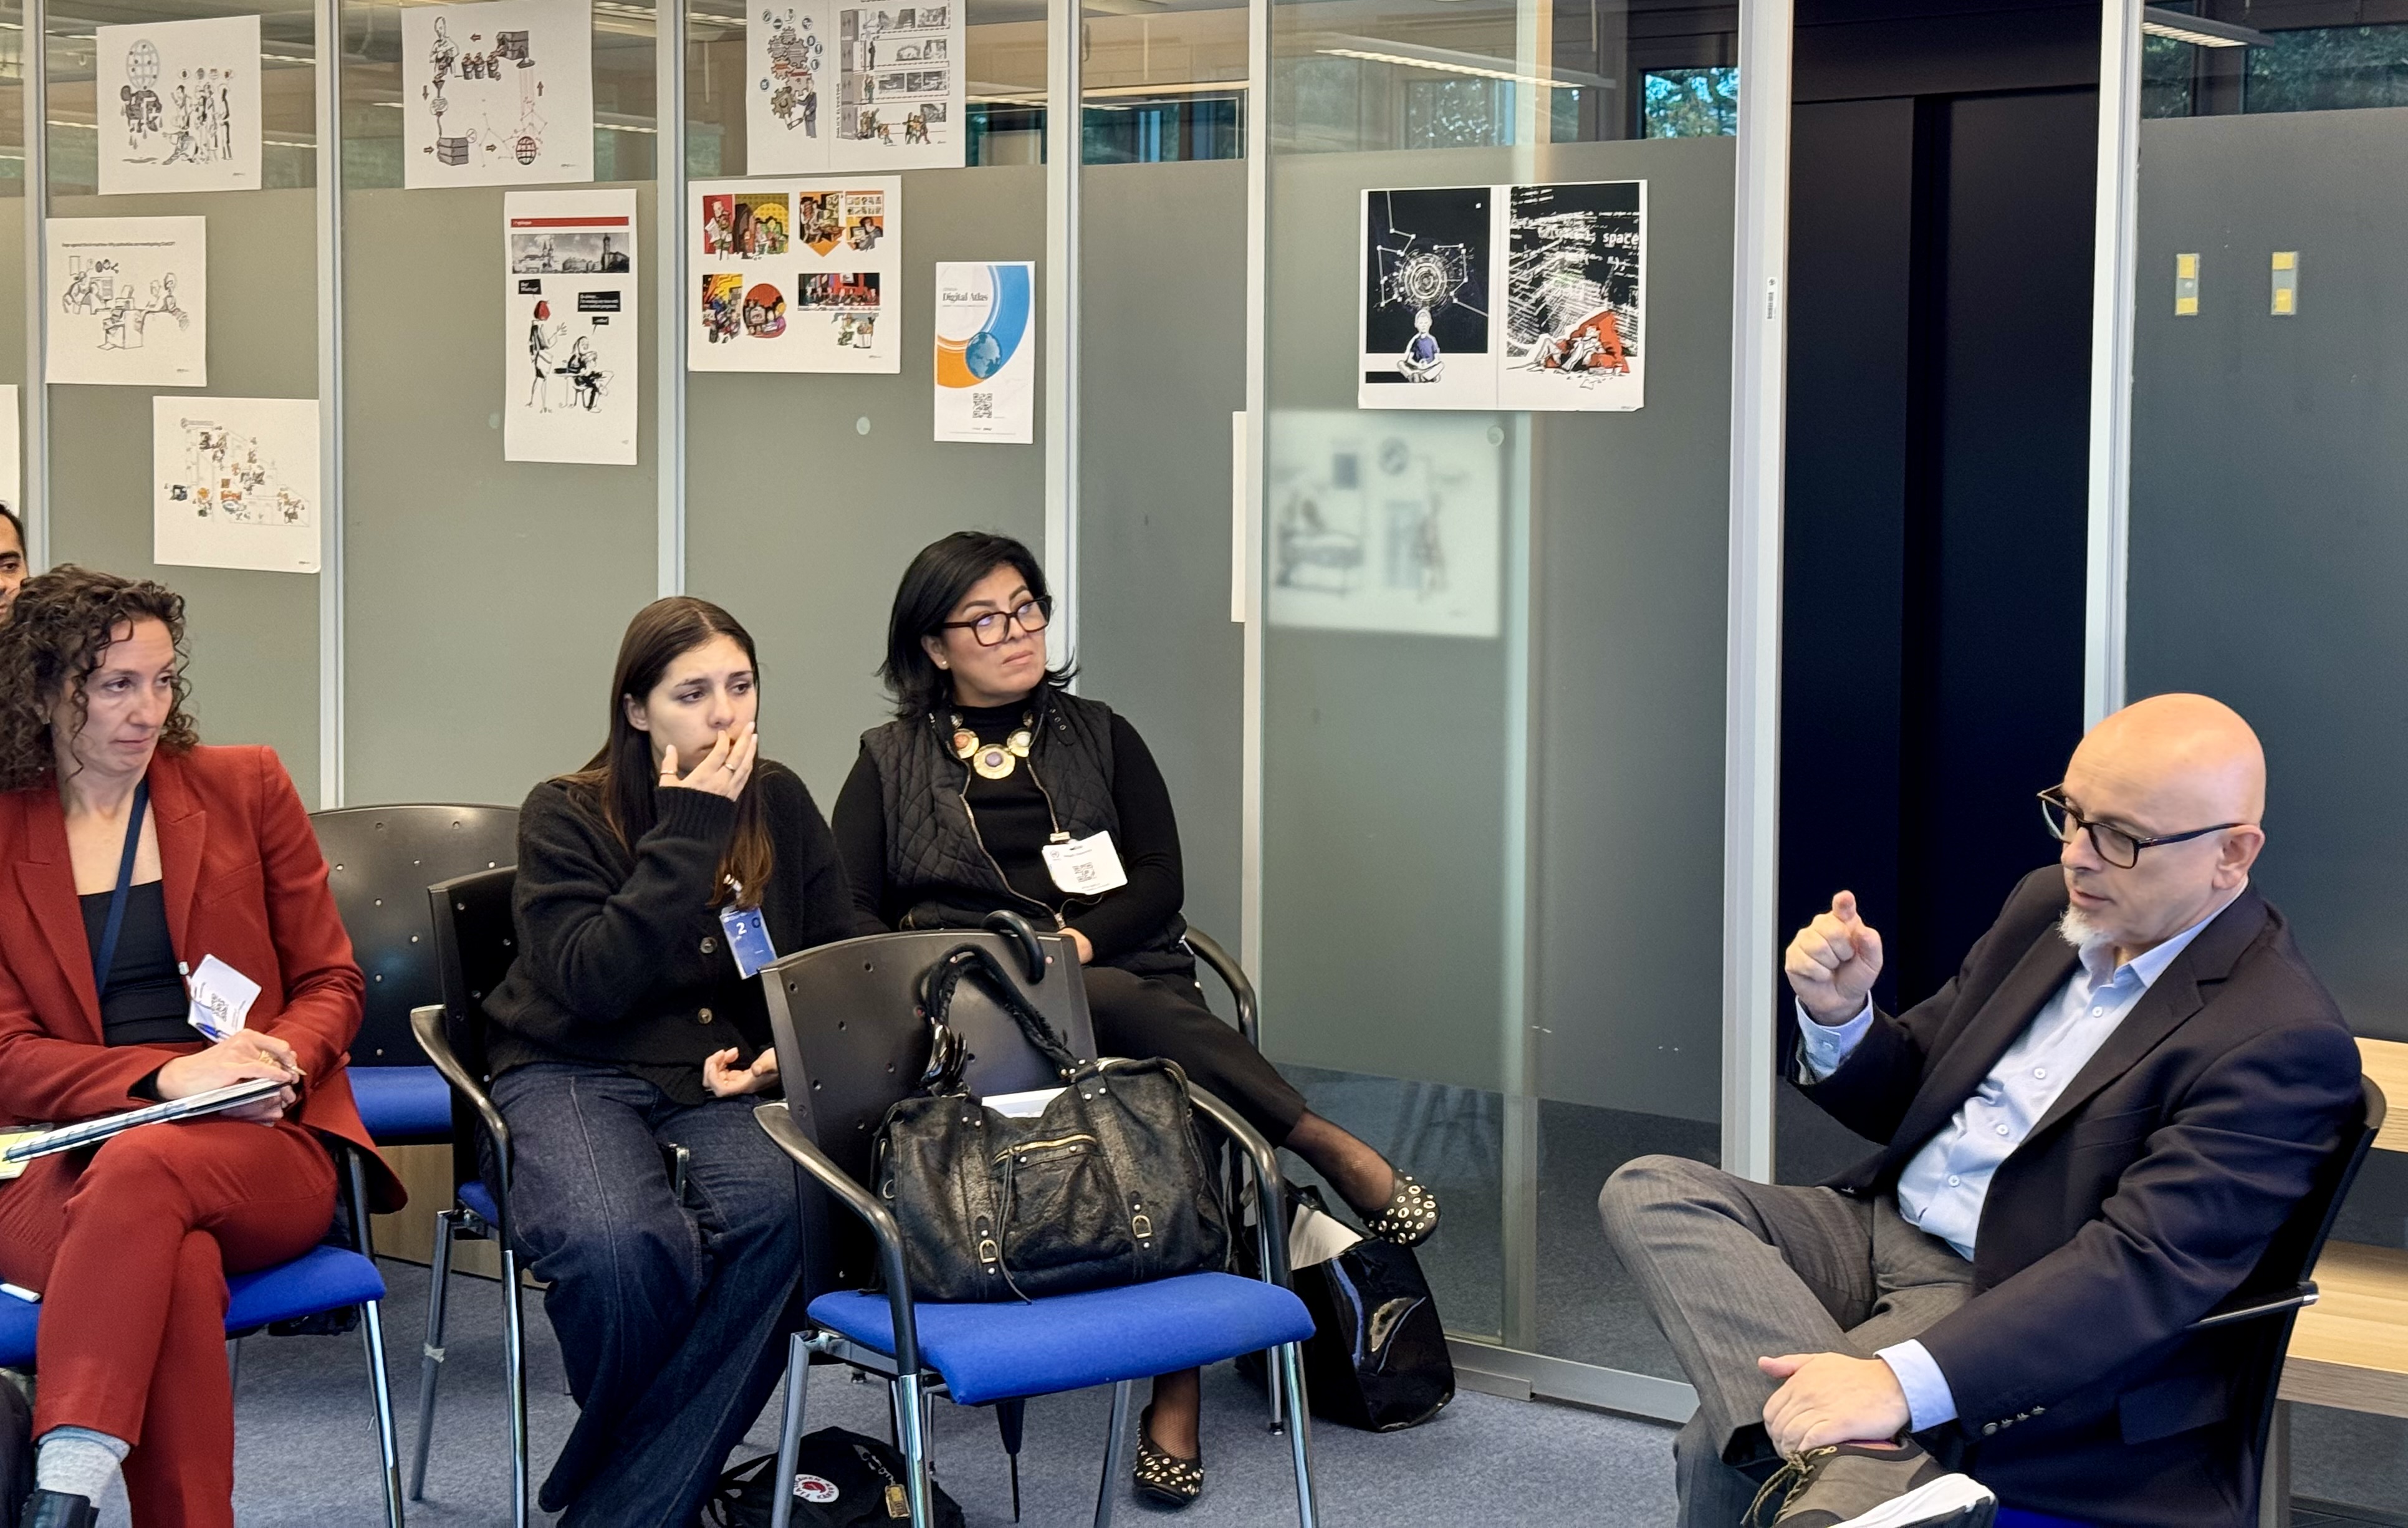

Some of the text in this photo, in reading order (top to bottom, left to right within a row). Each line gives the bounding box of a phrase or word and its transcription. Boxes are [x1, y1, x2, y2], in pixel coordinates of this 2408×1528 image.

[1603, 233, 1639, 246] space
[943, 292, 988, 302] Digital Atlas
[736, 922, 747, 935] 2
